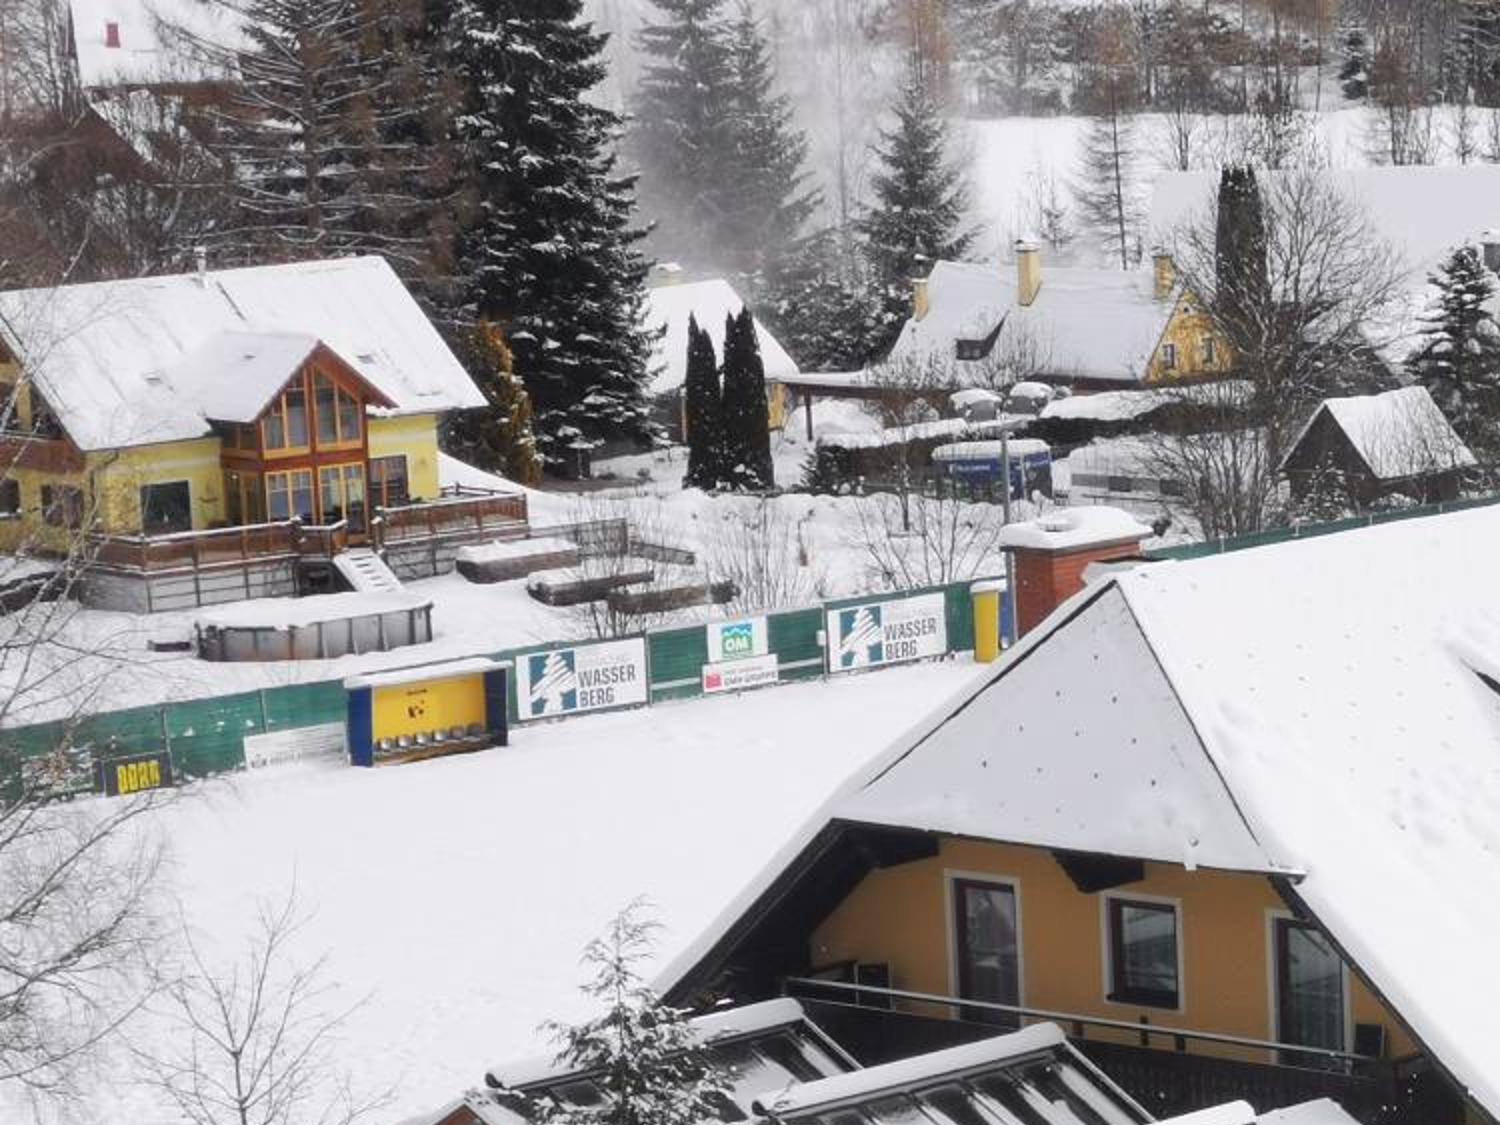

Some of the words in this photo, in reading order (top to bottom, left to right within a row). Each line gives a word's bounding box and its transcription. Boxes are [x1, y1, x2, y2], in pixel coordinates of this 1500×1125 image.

[884, 618, 936, 640] WASSER
[886, 640, 917, 660] BERG
[578, 664, 636, 688] WASSER
[580, 687, 615, 708] BERG
